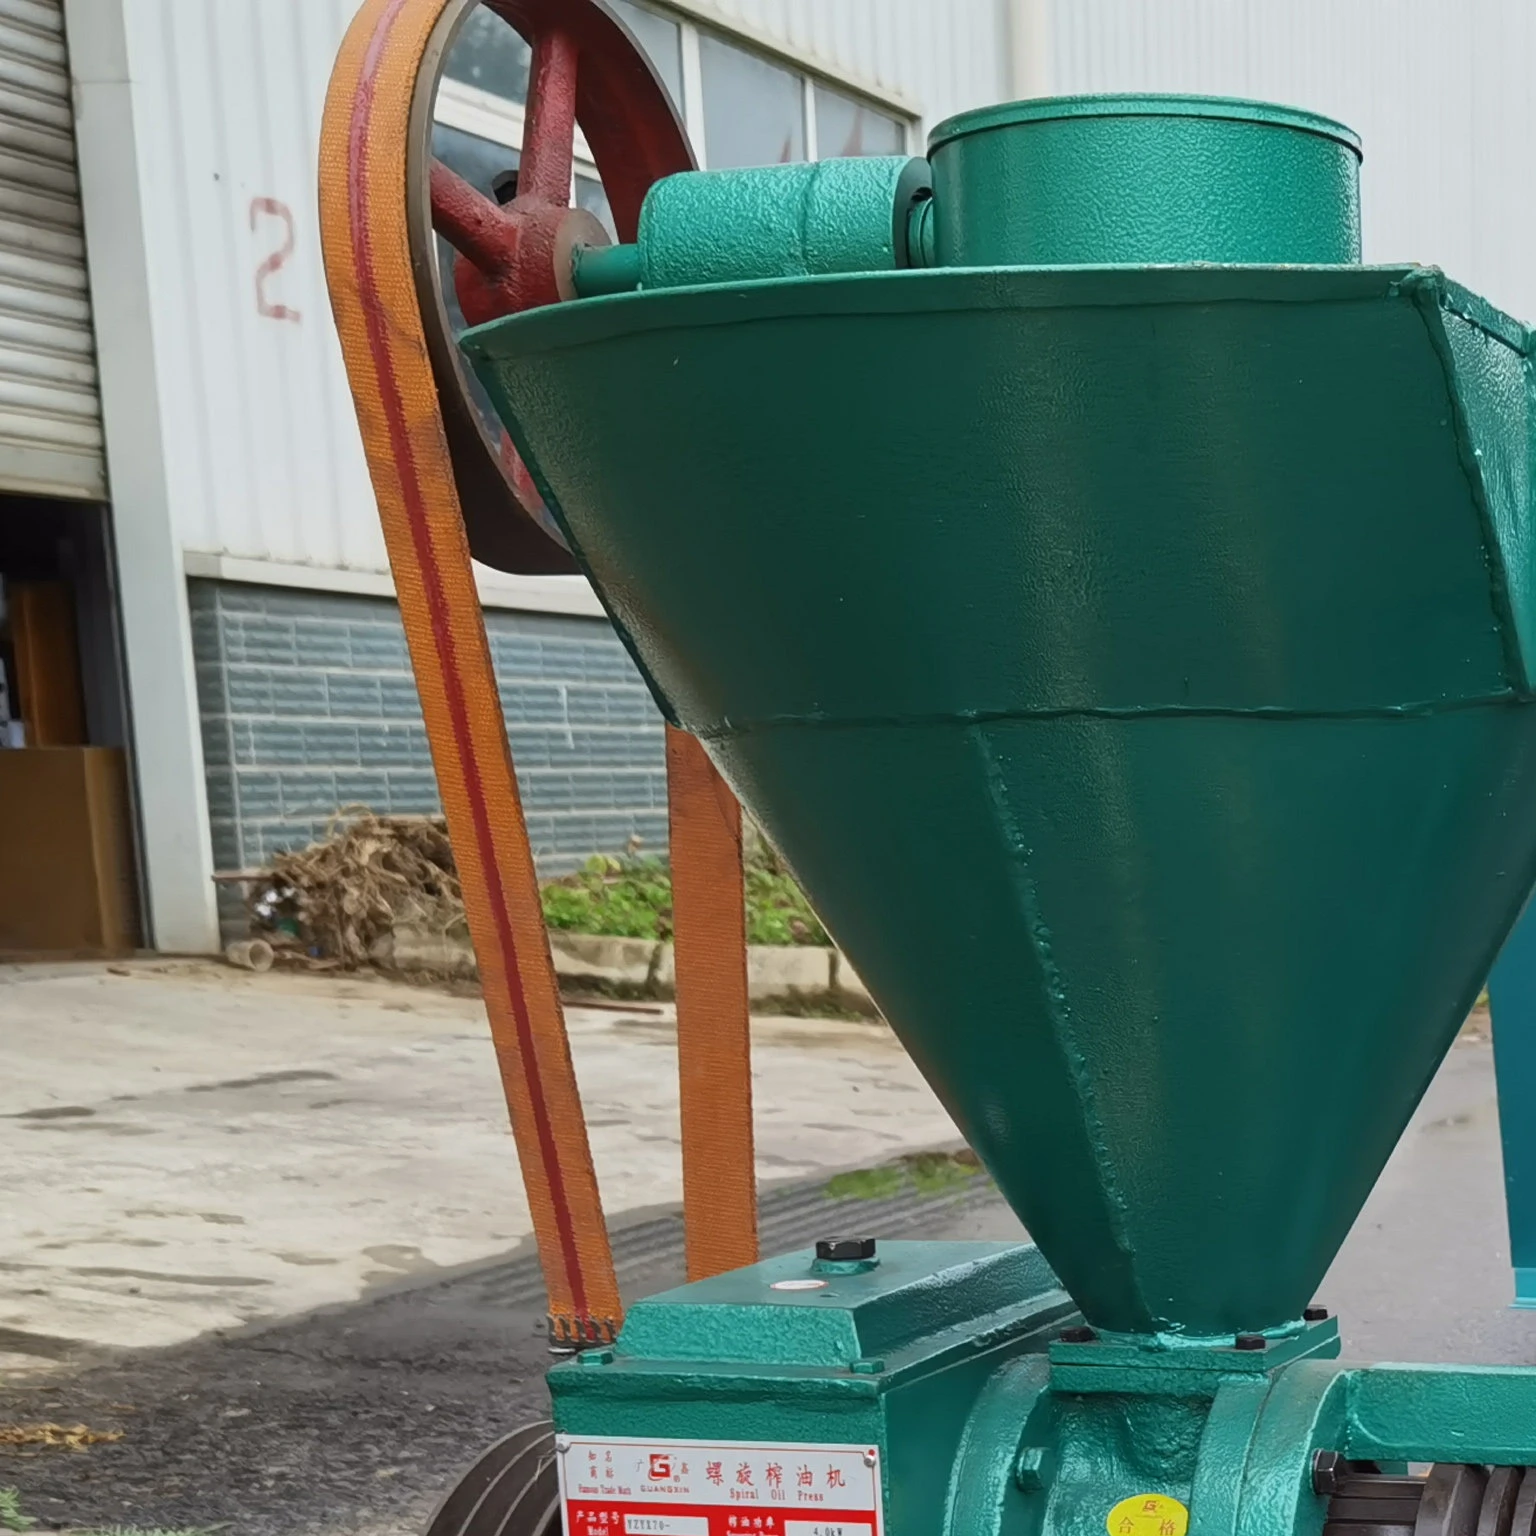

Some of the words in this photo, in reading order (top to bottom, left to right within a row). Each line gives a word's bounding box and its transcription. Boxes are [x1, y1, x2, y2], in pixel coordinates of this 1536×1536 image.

[249, 195, 302, 324] 2
[705, 1460, 846, 1489] 螺旋榨油机
[640, 1484, 690, 1494] GUANGXIN
[729, 1488, 759, 1501] Spiral
[771, 1489, 786, 1500] Oil
[797, 1490, 824, 1502] Press
[587, 1525, 609, 1536] Model
